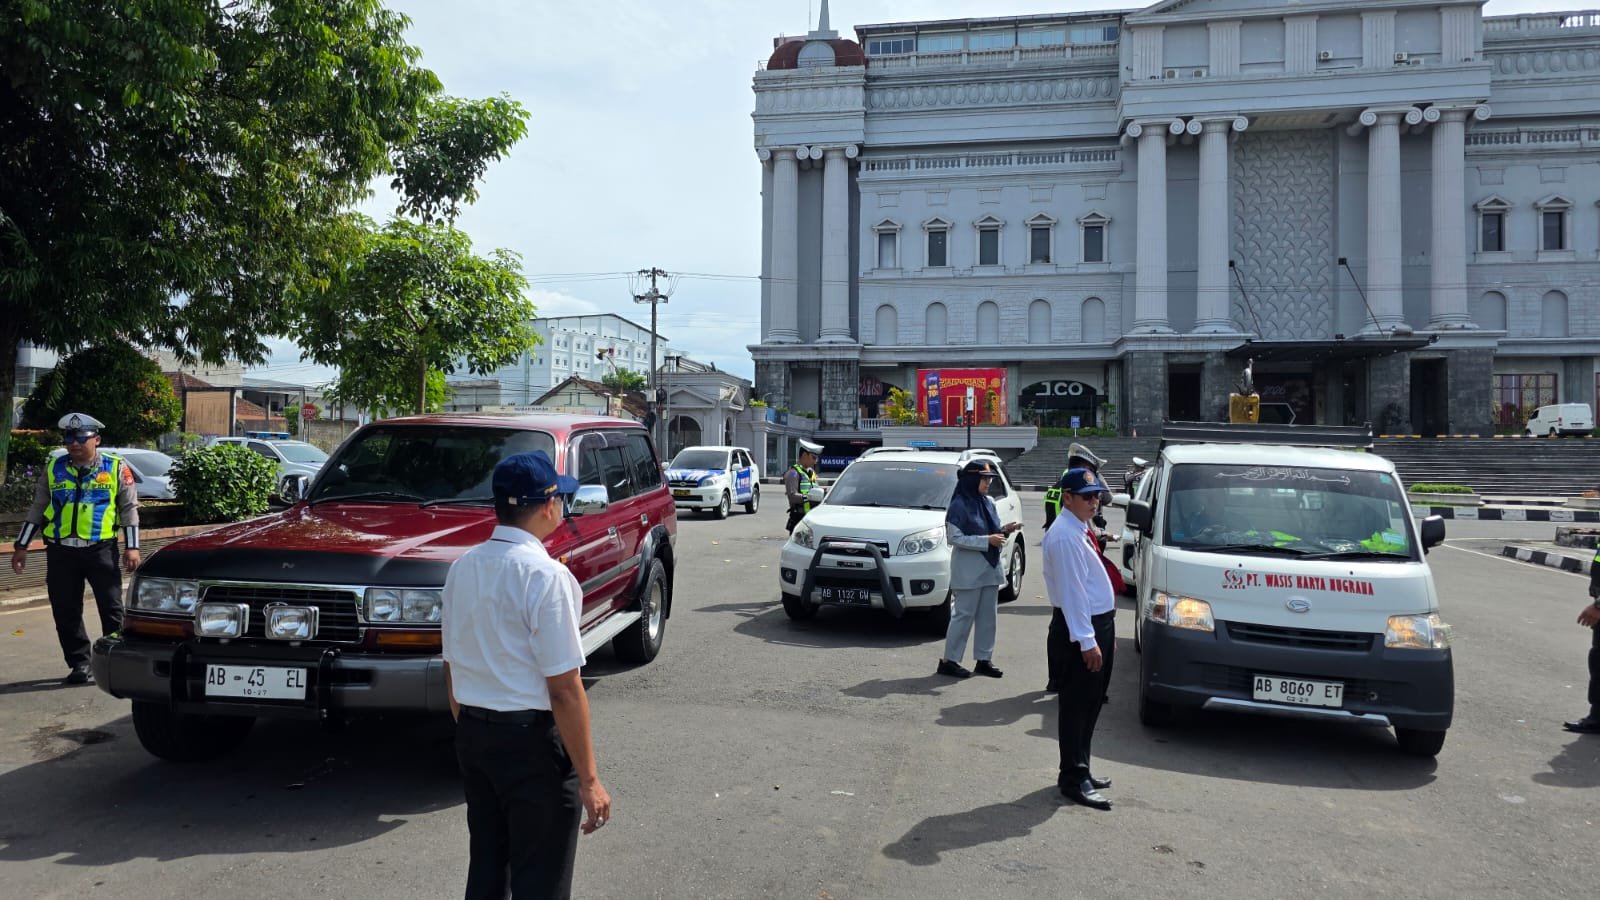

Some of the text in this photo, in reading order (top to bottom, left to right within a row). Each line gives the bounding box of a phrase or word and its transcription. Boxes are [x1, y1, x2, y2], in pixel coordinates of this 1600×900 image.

[1035, 381, 1083, 396] J.CO
[1246, 573, 1261, 587] PT.
[1265, 574, 1293, 588] WASIS
[823, 589, 832, 598] AB
[838, 590, 855, 599] 1132
[208, 667, 304, 688] AB 45 EL
[1255, 678, 1342, 698] AB 8069 ET
